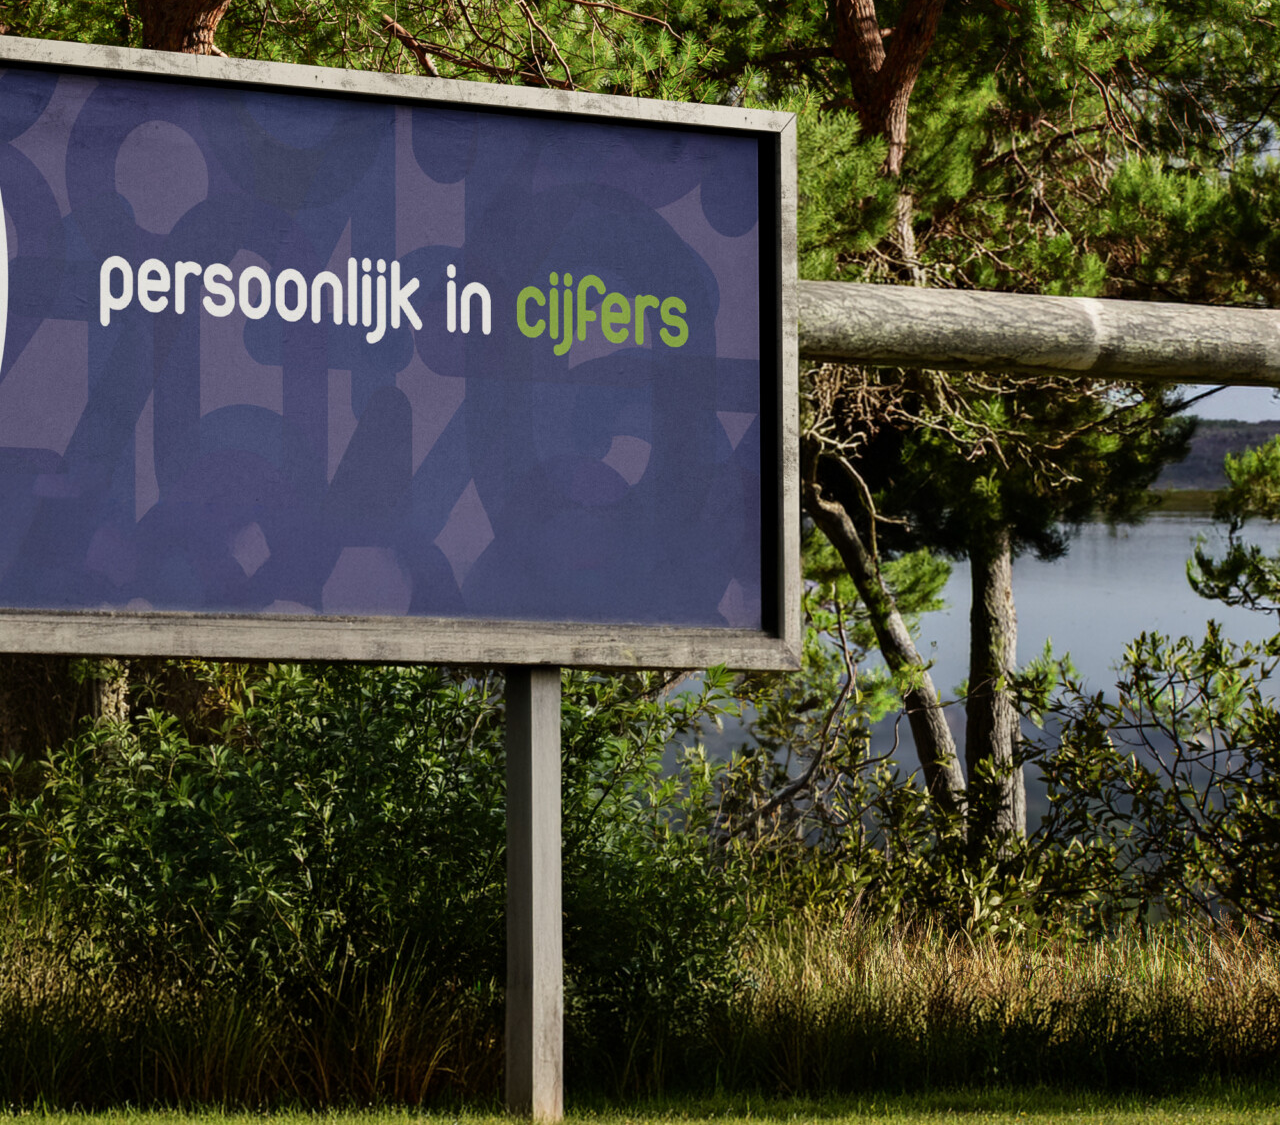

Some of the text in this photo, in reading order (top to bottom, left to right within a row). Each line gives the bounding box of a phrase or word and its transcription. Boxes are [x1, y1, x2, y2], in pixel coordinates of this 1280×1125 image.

[100, 256, 688, 355] persoonlijk in cijfers
